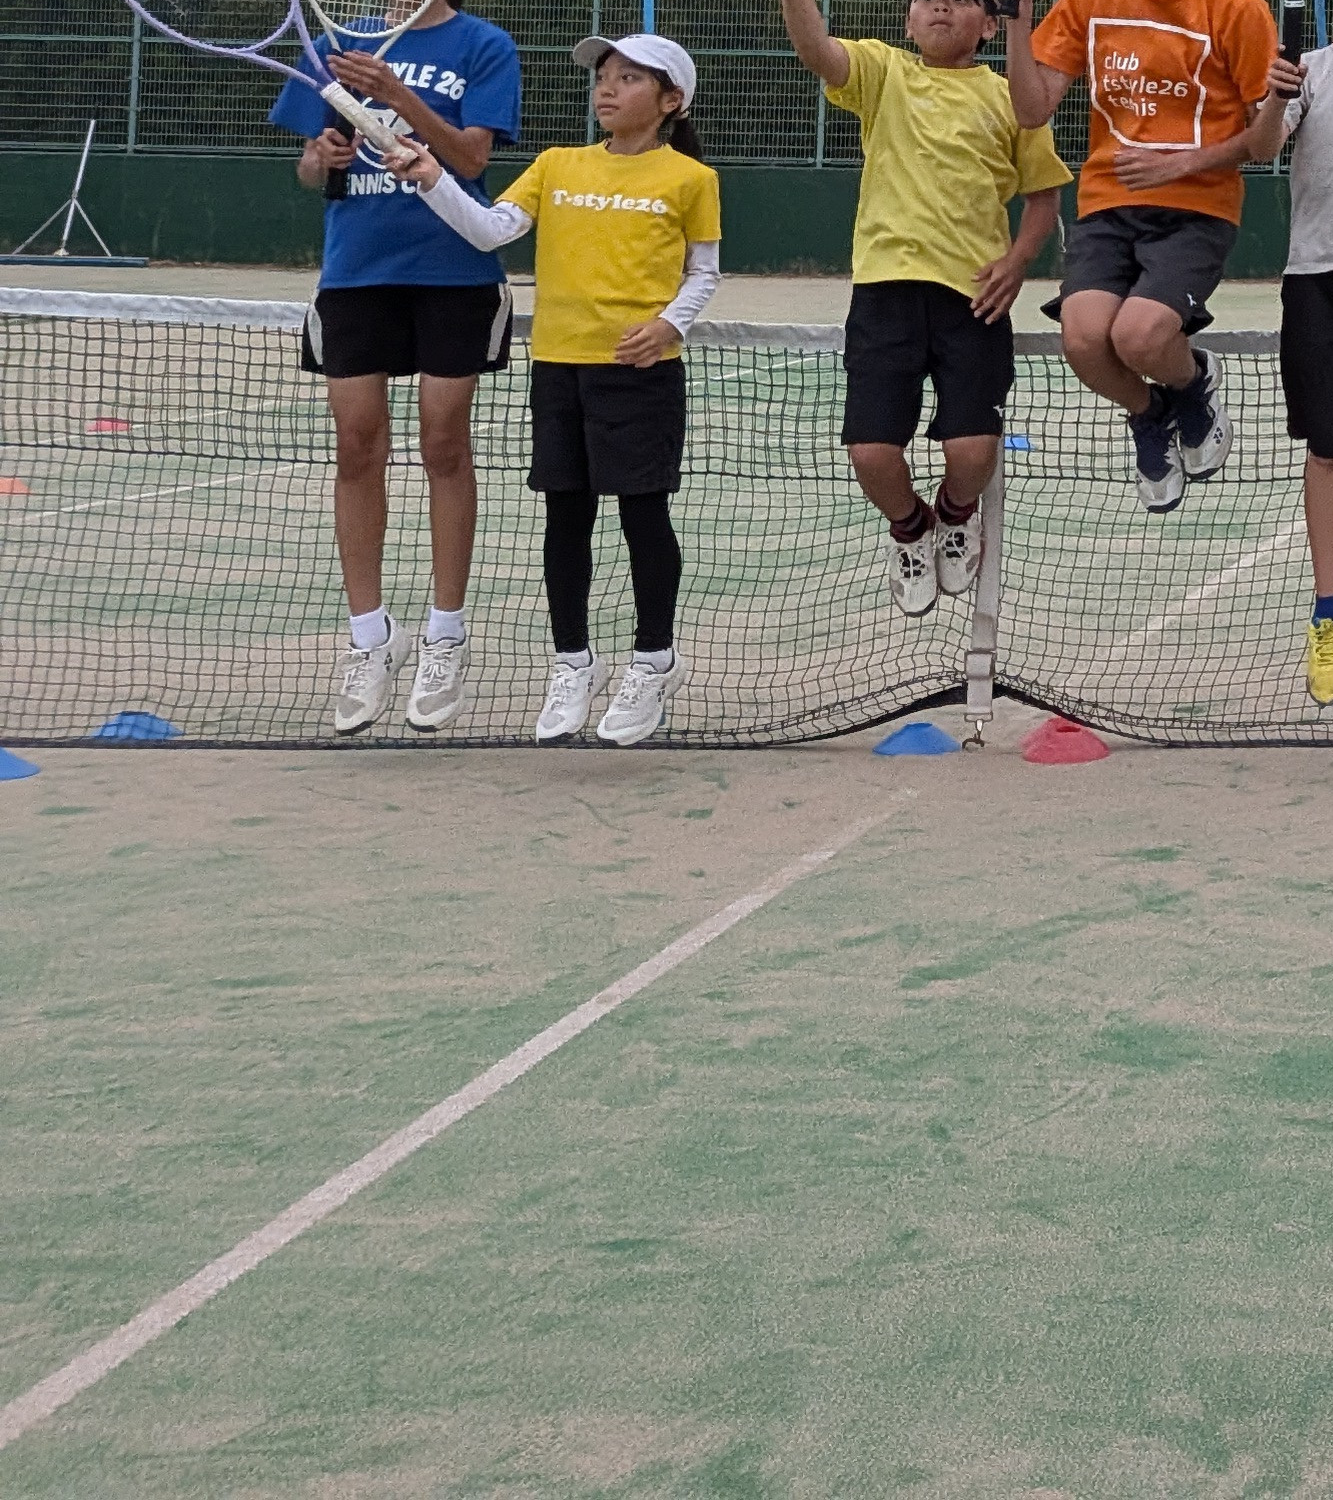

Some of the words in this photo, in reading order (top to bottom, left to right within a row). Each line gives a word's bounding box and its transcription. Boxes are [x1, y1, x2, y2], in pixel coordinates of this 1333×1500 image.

[1104, 51, 1139, 71] club
[386, 62, 437, 88] YLE
[433, 70, 467, 101] 26
[1103, 74, 1188, 98] tstyle26
[552, 189, 668, 214] T-style26
